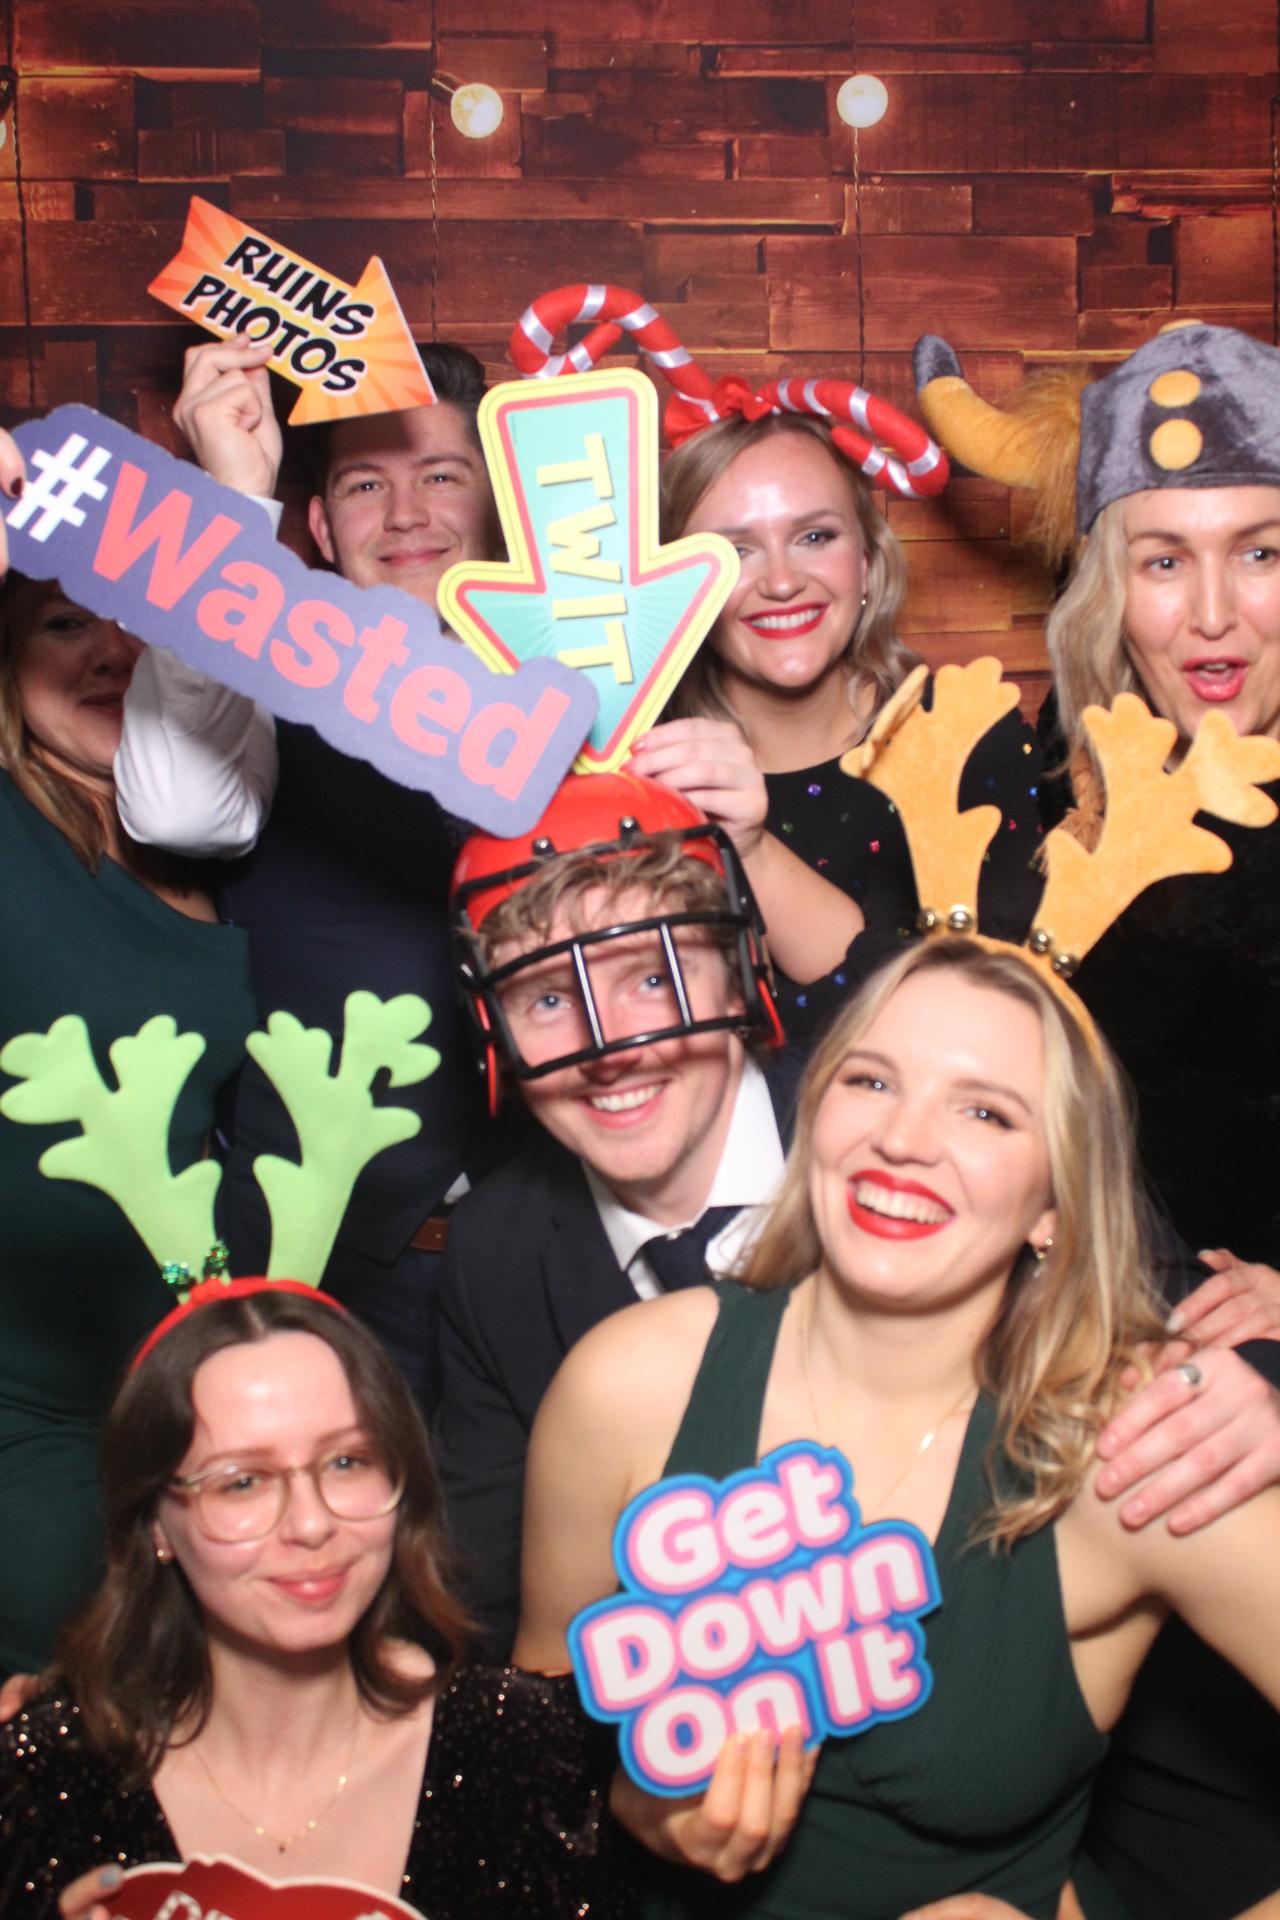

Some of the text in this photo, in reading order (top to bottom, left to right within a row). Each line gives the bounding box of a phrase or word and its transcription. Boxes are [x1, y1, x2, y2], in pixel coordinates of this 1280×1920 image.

[182, 275, 366, 391] PHOTOS
[224, 236, 375, 335] RUINS
[5, 433, 571, 801] #Wasted
[536, 432, 634, 685] TWIT
[632, 1457, 846, 1591] Get
[587, 1538, 923, 1706] Down
[821, 1625, 917, 1722] It
